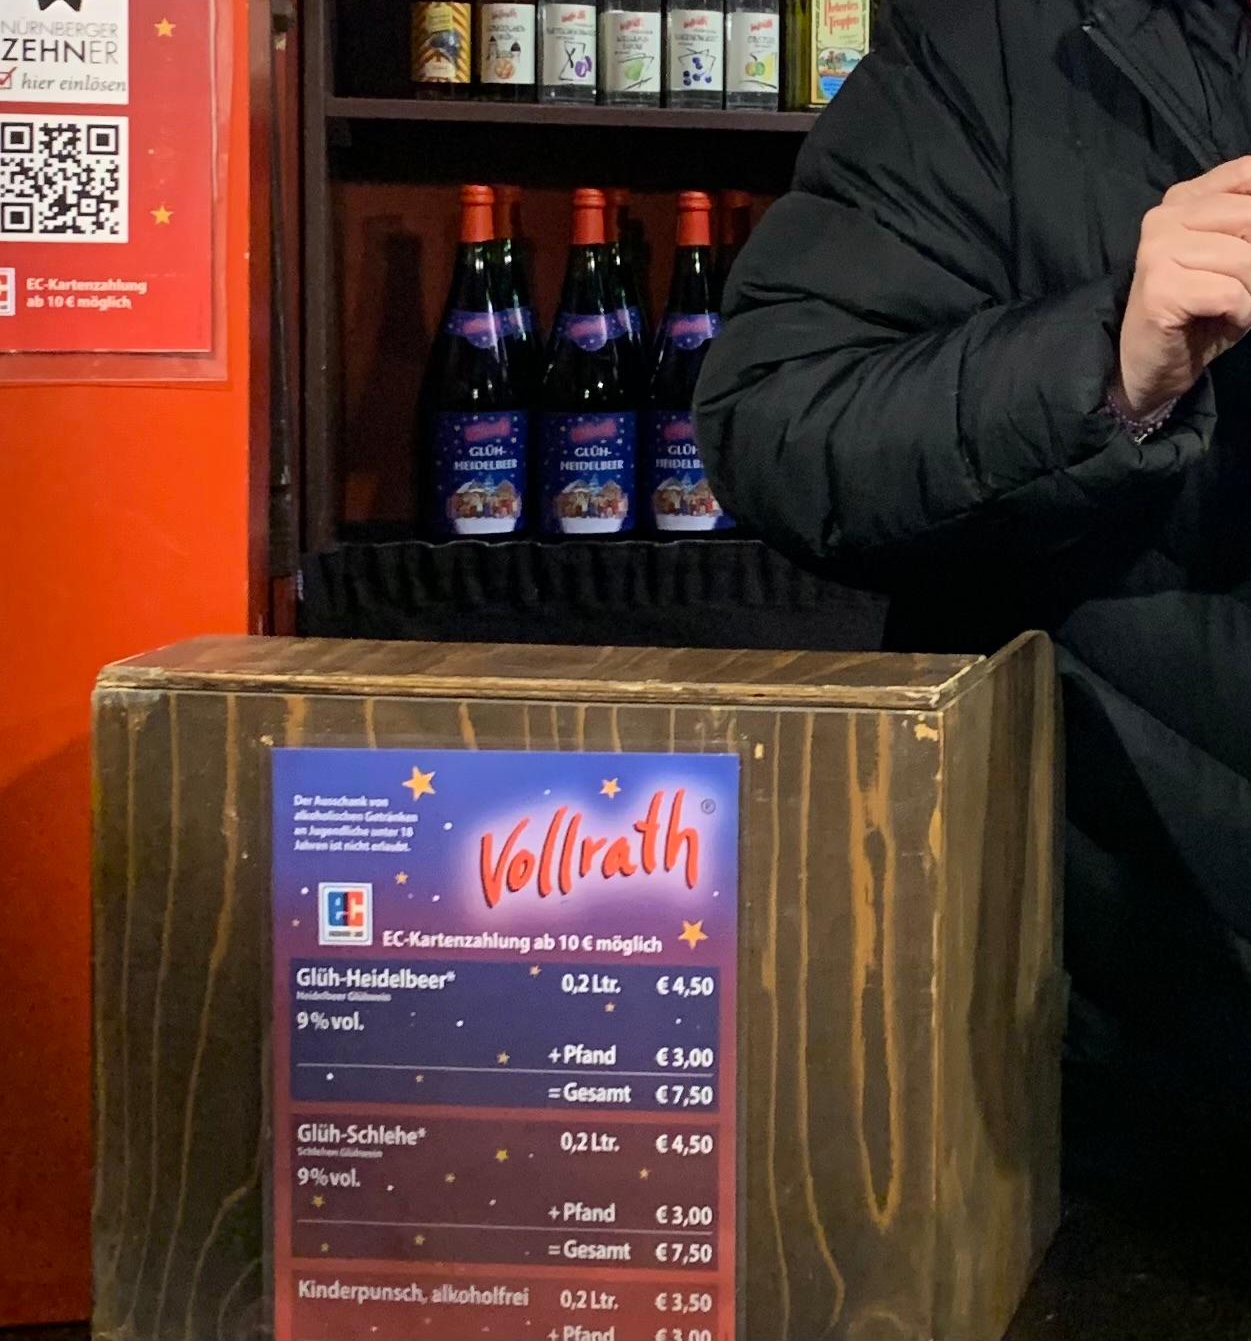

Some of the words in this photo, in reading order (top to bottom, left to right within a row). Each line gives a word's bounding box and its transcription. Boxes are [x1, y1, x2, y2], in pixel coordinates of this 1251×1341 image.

[1, 16, 118, 38] NÜRNBERGER
[2, 38, 119, 65] ZEHNER
[22, 72, 55, 90] hier
[60, 75, 126, 92] einlösen
[26, 277, 147, 295] EC-Kartenzahlung
[26, 294, 44, 308] ab
[48, 295, 64, 308] 10
[77, 295, 132, 311] möglich
[479, 787, 698, 909] Vollrath
[382, 930, 530, 954] EC-Kartenzahlung
[533, 932, 556, 951] ab
[559, 934, 580, 952] 10
[596, 934, 662, 955] möglich
[561, 974, 589, 995] 0,2
[592, 974, 621, 994] Ltr.
[672, 976, 714, 998] 4,50
[563, 1044, 617, 1065] Pfand
[672, 1047, 714, 1069] 3,00
[563, 1082, 632, 1103] Gesamt
[672, 1085, 713, 1107] 7,50
[560, 1132, 588, 1154] 0,2
[591, 1132, 620, 1152] Ltr.
[671, 1135, 713, 1156] 4,50
[563, 1202, 616, 1222] Pfand
[671, 1206, 713, 1227] 3,00
[563, 1239, 631, 1260] Gesamt
[671, 1243, 713, 1265] 7,50
[431, 1283, 530, 1307] alkoholfrei
[560, 1290, 587, 1312] 0,2
[591, 1291, 619, 1311] Ltr.
[671, 1293, 713, 1314] 3,50
[563, 1326, 615, 1341] Pfand
